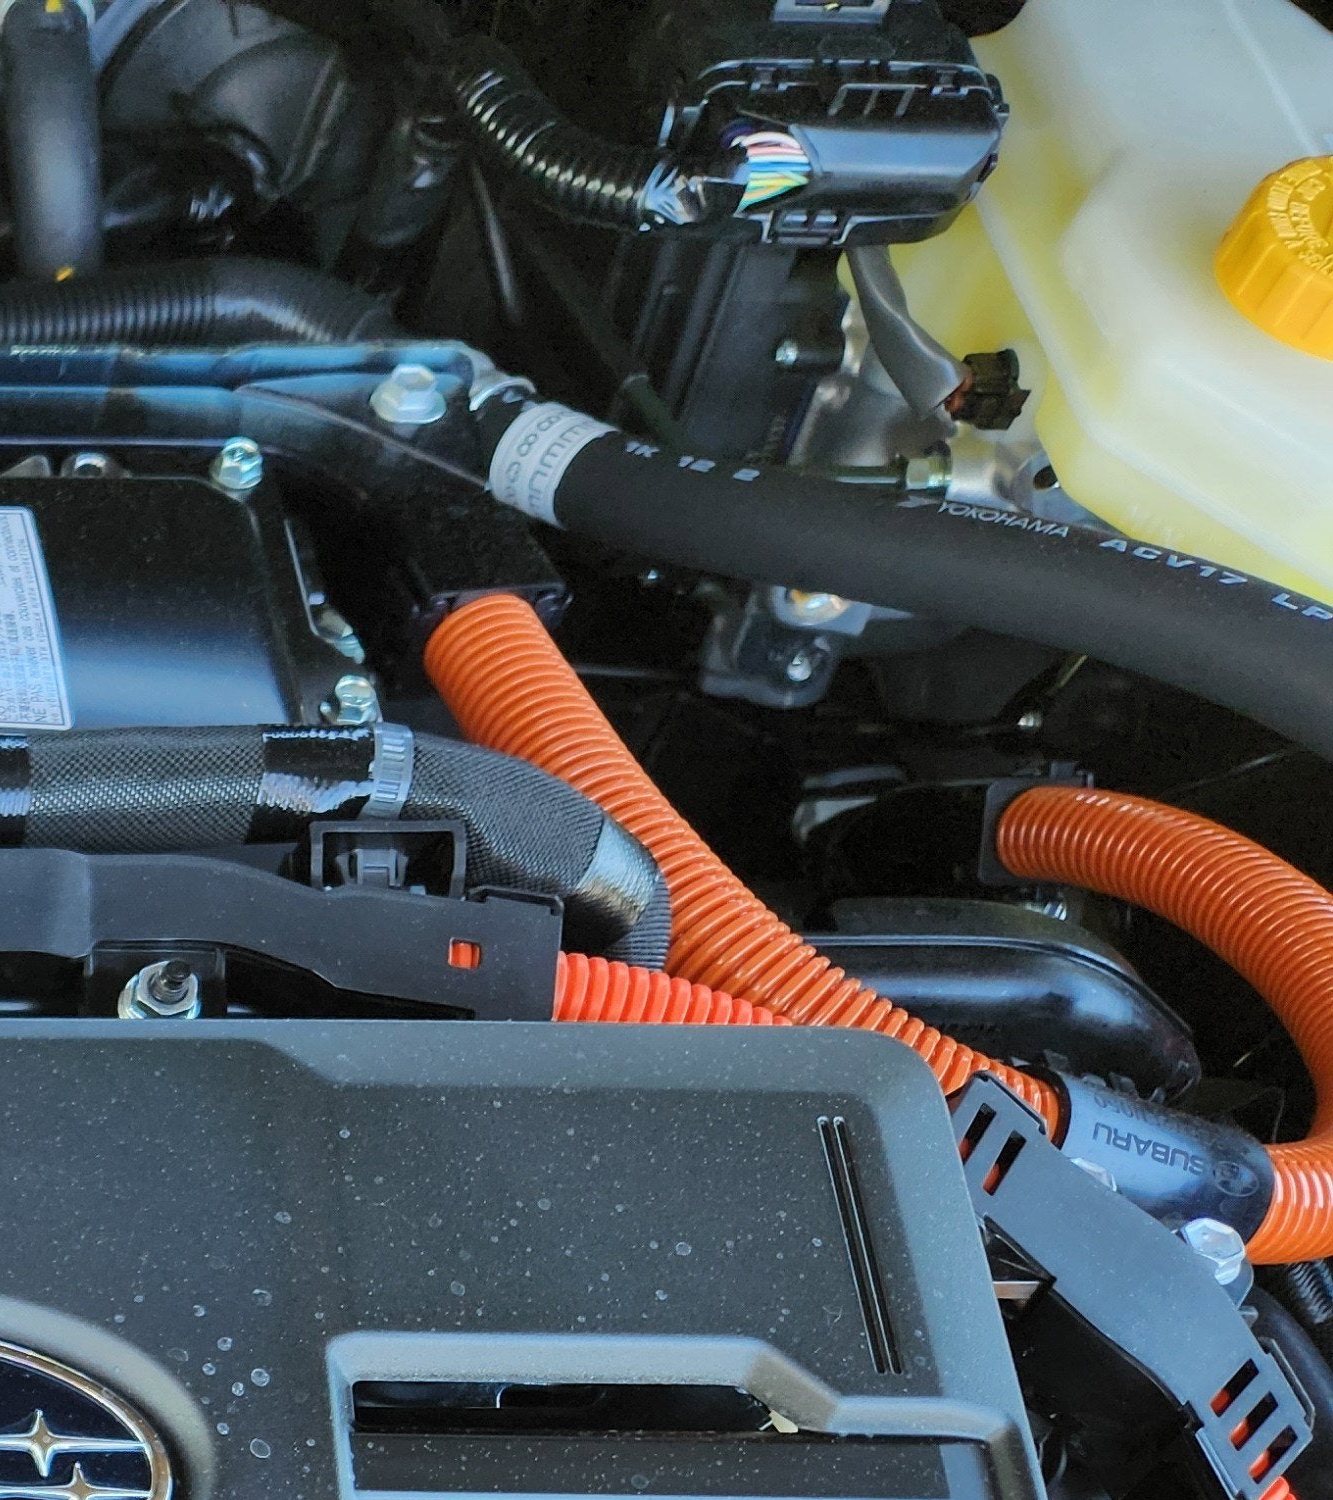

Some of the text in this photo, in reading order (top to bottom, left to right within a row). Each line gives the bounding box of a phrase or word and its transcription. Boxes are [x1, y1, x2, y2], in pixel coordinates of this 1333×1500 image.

[939, 501, 1071, 540] YOKOHAMA
[1099, 538, 1250, 587] ACV17
[27, 683, 43, 703] PAS
[30, 707, 47, 723] NE
[1092, 1121, 1206, 1176] SUBARU
